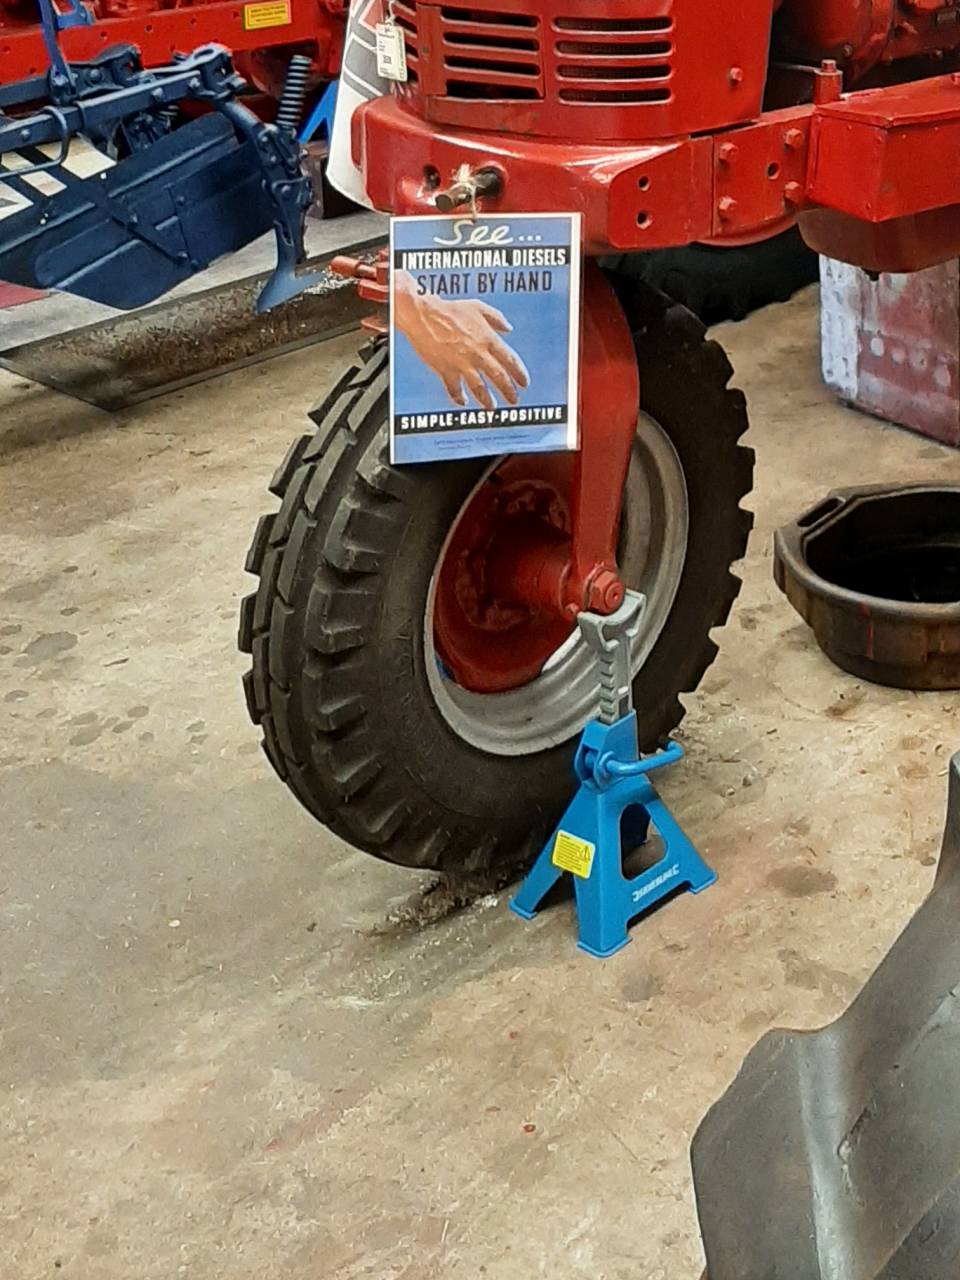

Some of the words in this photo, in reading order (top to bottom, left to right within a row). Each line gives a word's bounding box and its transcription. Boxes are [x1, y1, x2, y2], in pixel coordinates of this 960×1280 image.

[402, 250, 509, 271] INTERNATIONAL
[512, 248, 566, 266] DIESELS
[417, 272, 471, 296] START
[477, 272, 498, 294] BY
[504, 270, 553, 293] HAND
